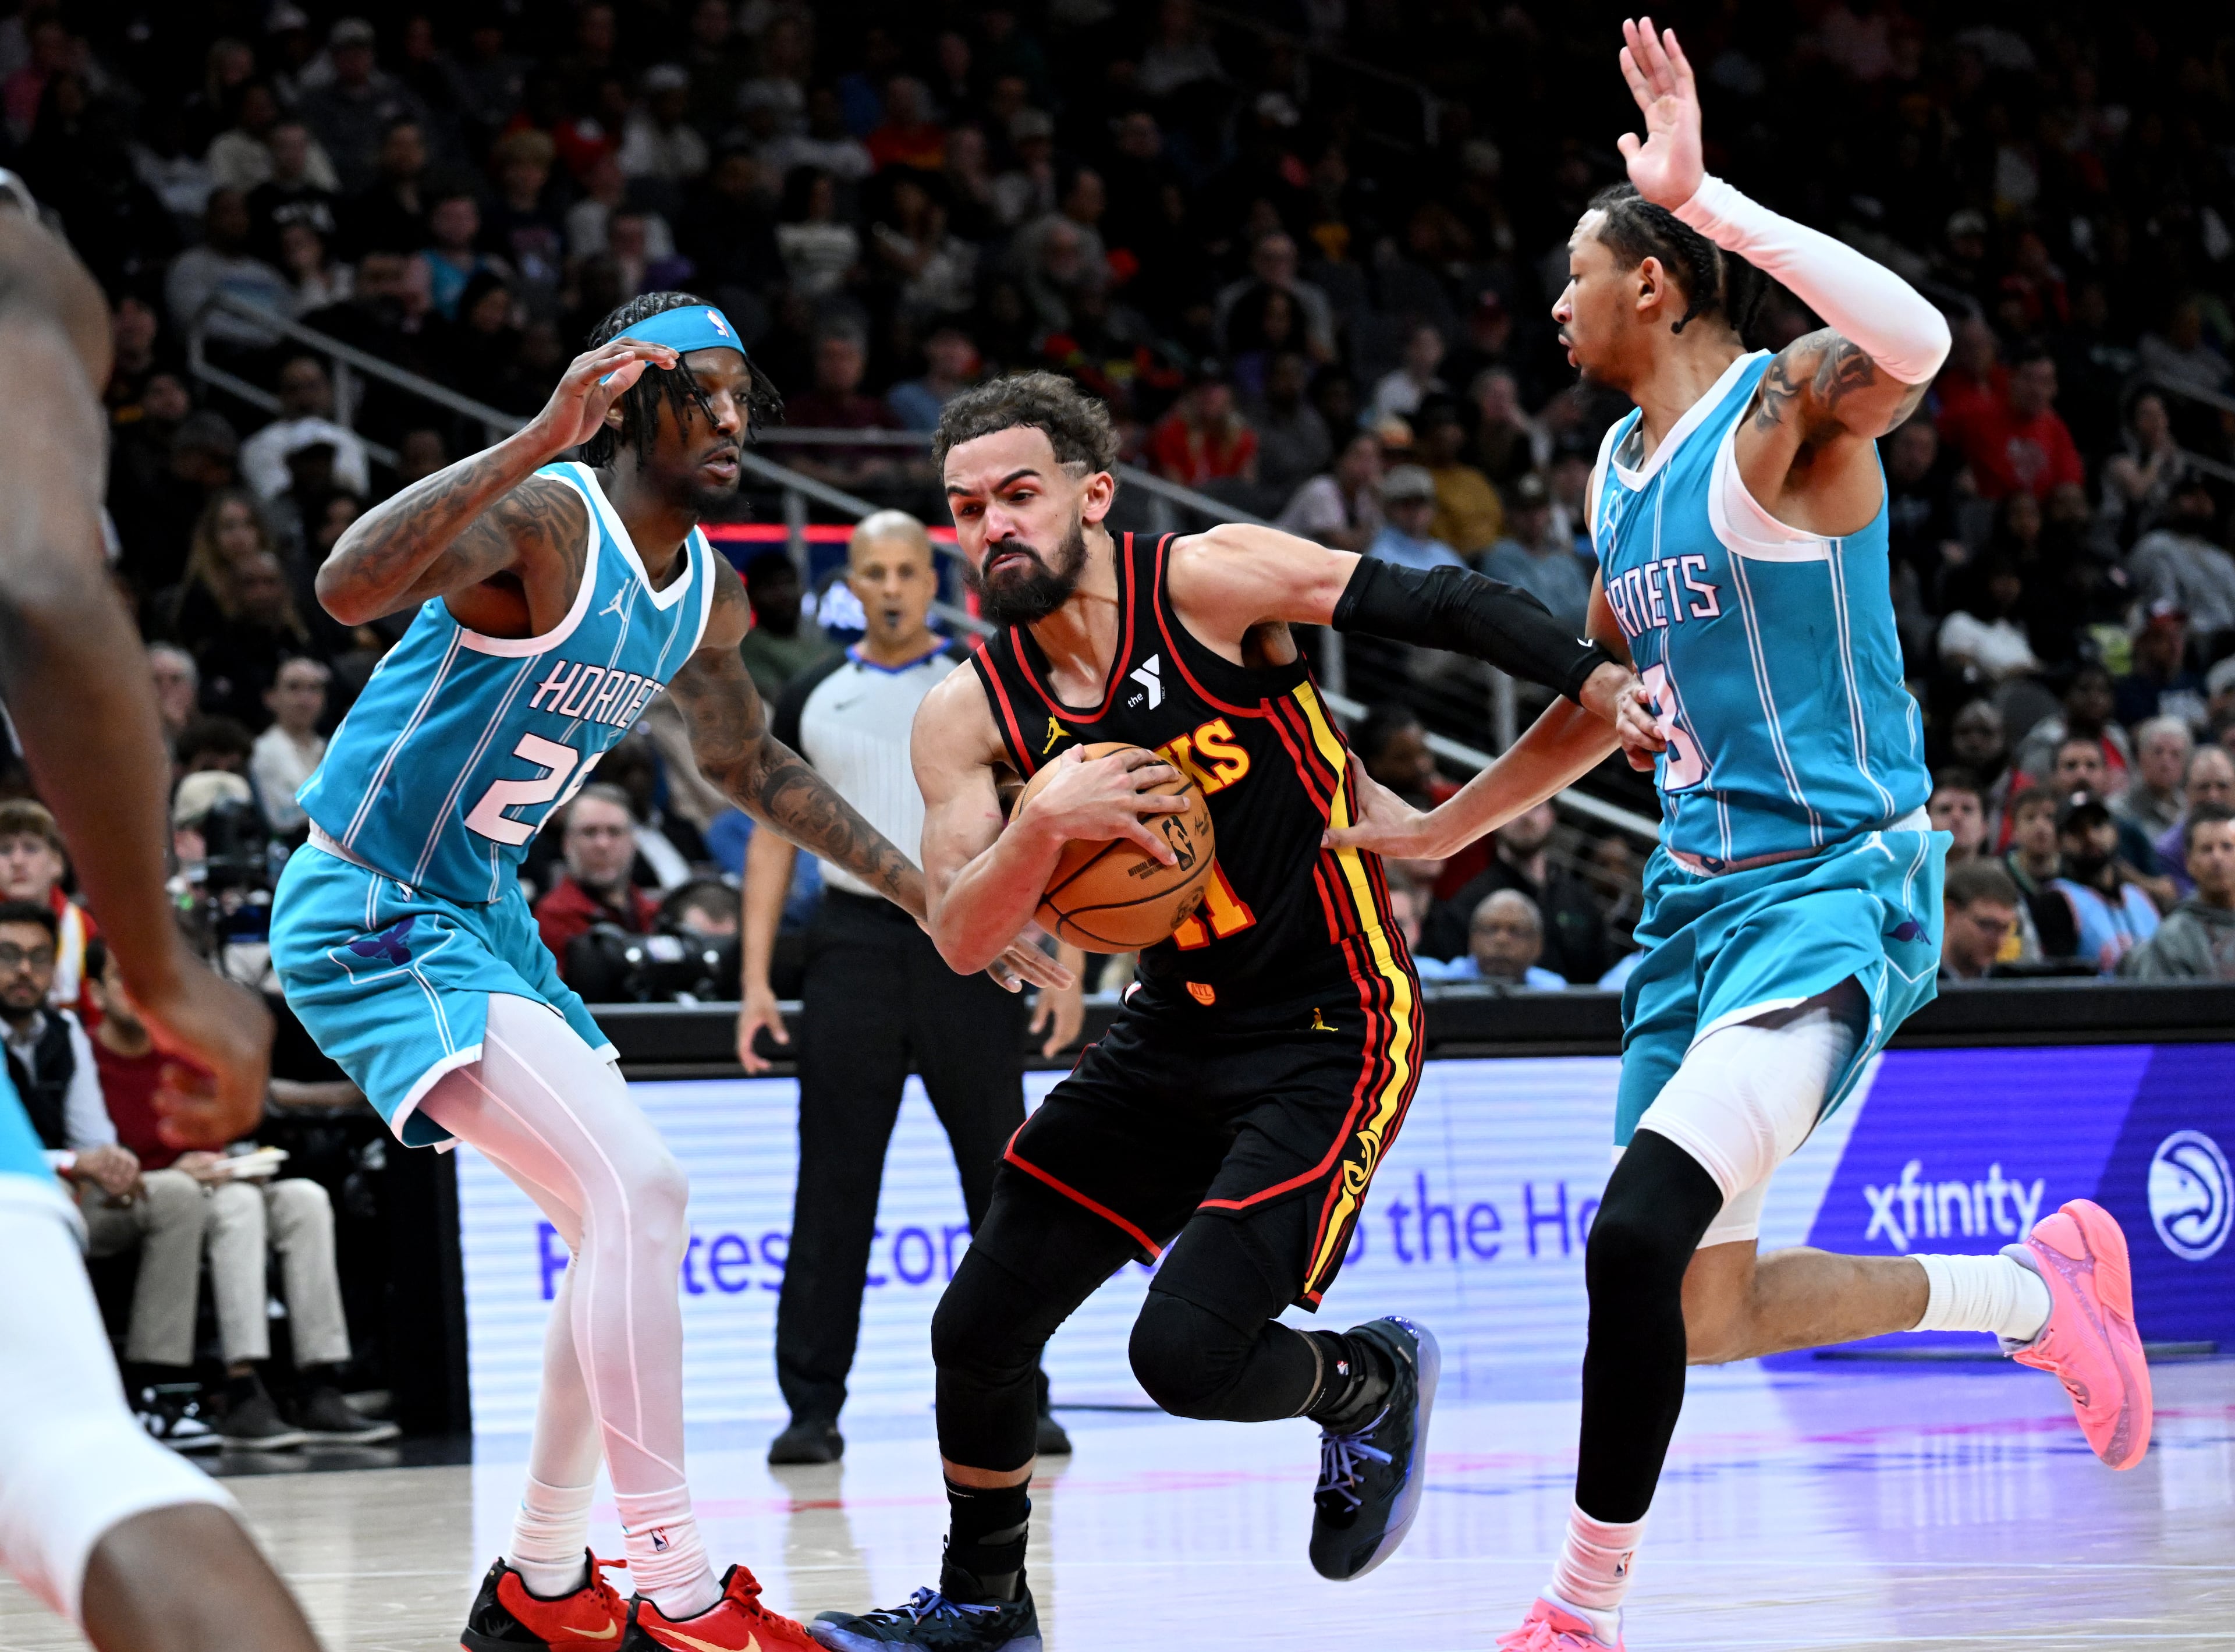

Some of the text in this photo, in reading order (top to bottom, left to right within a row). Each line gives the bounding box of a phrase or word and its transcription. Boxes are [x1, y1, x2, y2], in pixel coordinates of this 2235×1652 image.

[528, 660, 665, 728] HORNET
[1127, 693, 1144, 708] the
[1191, 983, 1212, 997] ATL
[1387, 1170, 1502, 1262] the
[1864, 1159, 2045, 1251] xfinity
